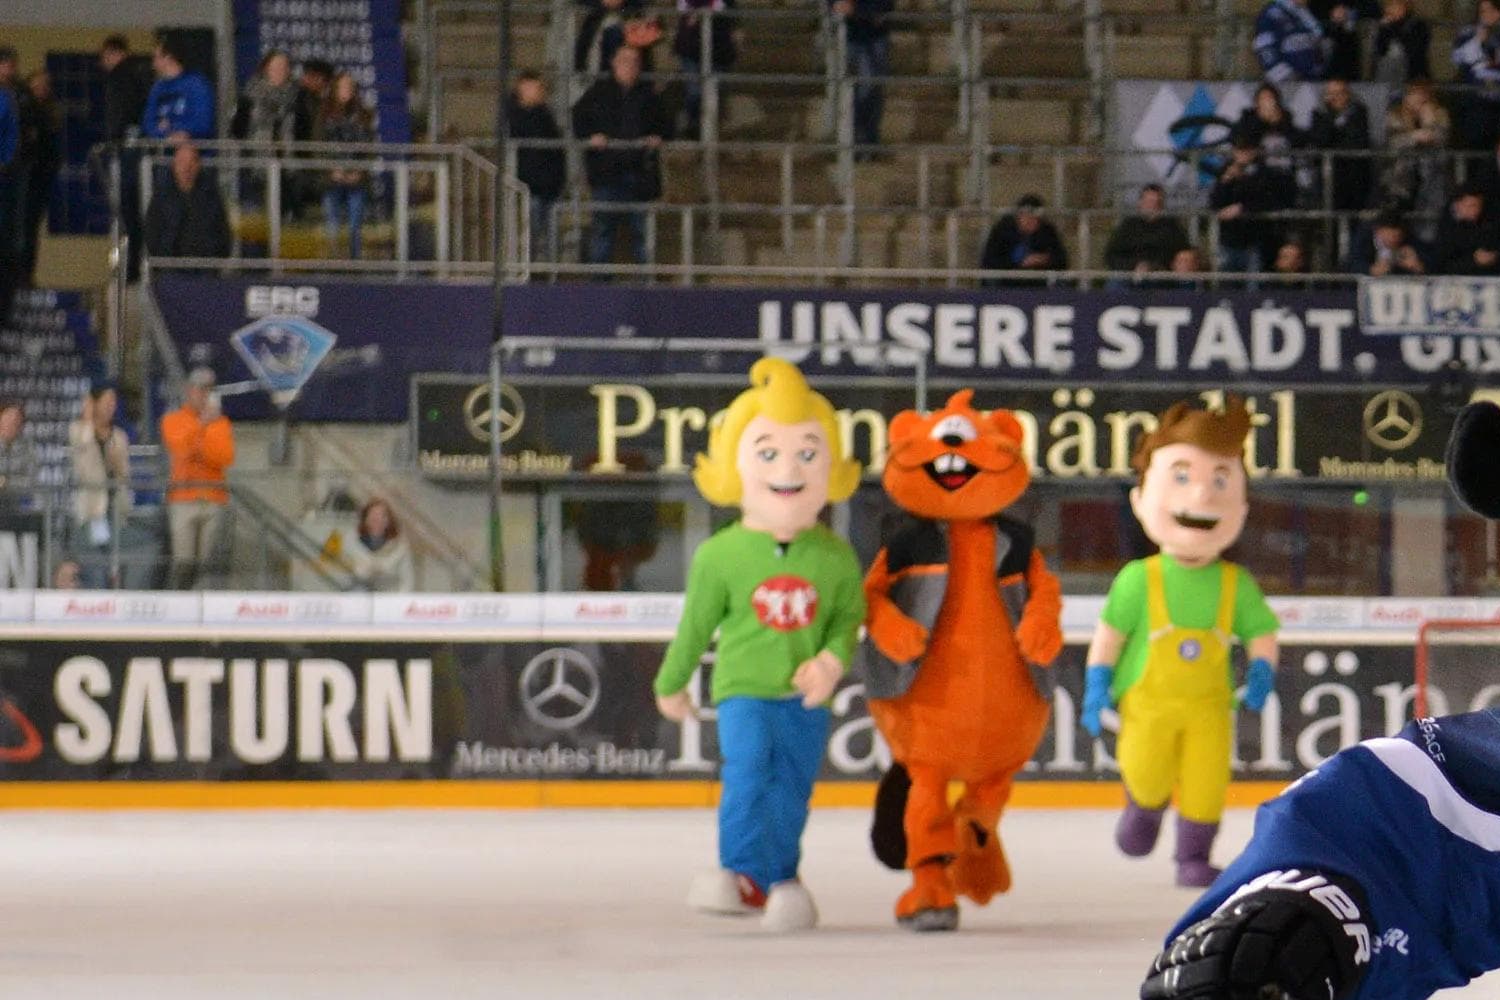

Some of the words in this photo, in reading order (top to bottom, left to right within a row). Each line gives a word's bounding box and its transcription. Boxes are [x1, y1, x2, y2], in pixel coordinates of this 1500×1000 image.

[758, 301, 1074, 371] UNSERE
[1098, 304, 1378, 374] STADT.
[65, 600, 117, 615] Audi
[237, 601, 289, 617] Audi
[404, 602, 457, 617] Audi
[576, 603, 628, 617] Audi
[53, 656, 433, 765] SATURN
[455, 741, 666, 774] Mercedes-Benz
